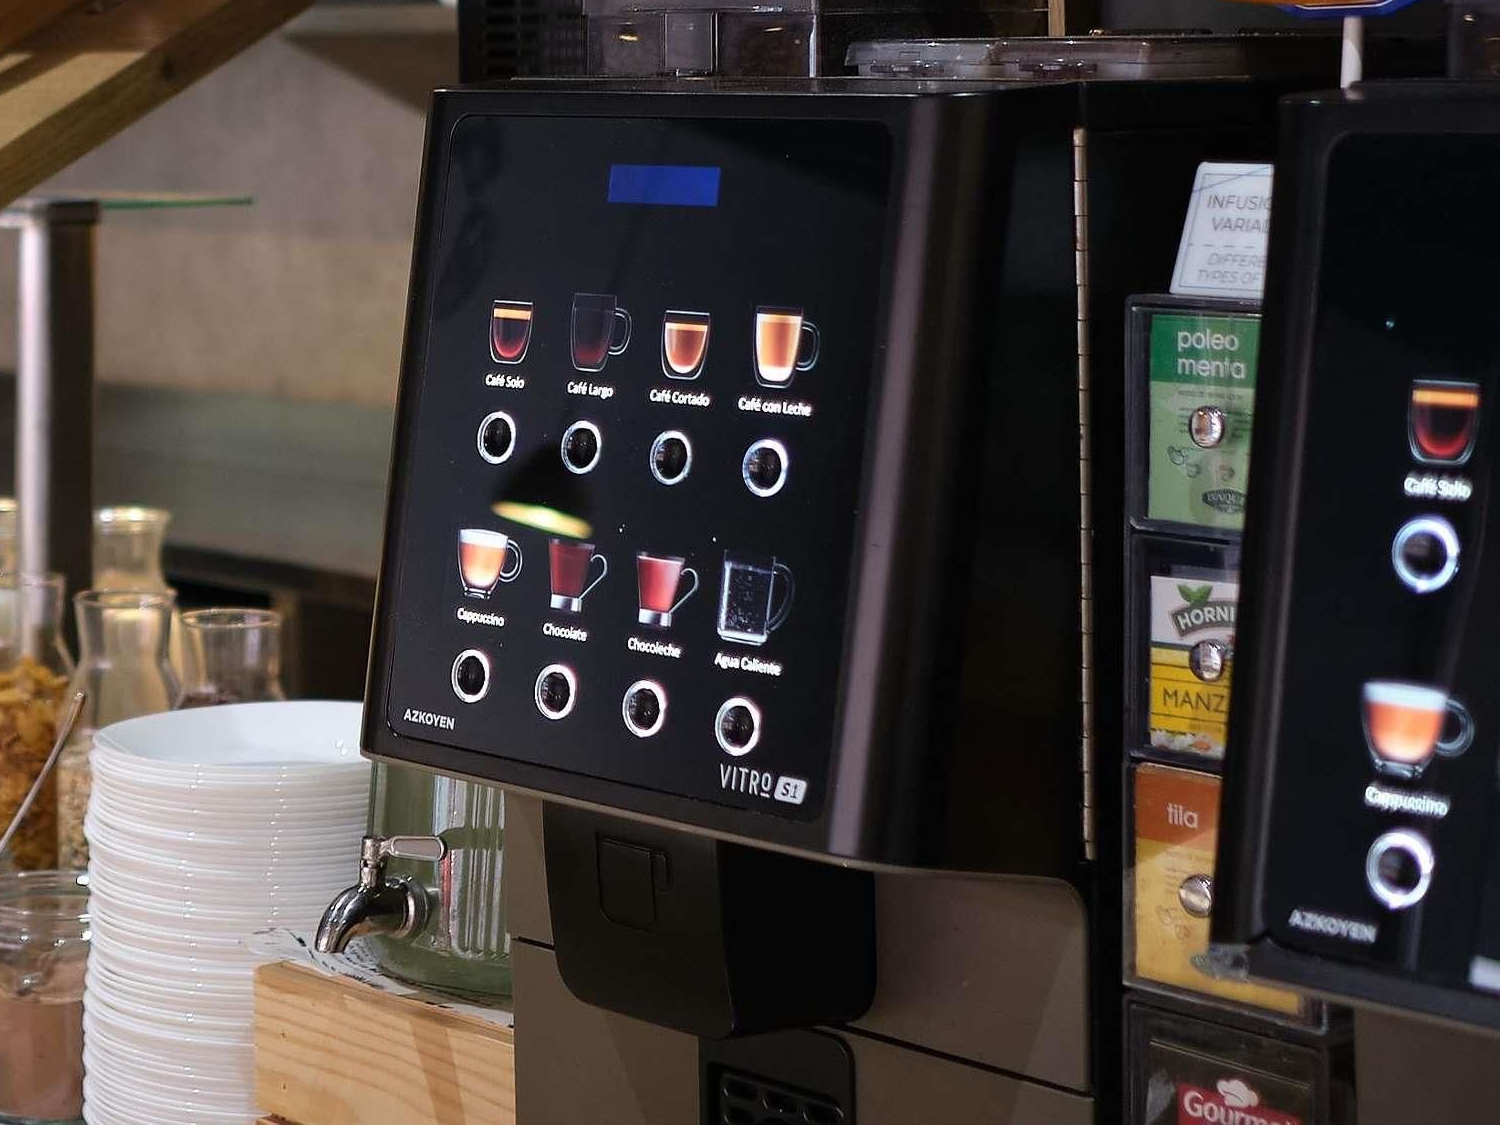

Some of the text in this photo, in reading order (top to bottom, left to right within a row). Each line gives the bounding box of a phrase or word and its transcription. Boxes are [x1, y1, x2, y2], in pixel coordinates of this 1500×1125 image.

[1177, 329, 1239, 352] poleo
[1178, 357, 1246, 379] menta
[485, 374, 525, 389] Café Solo
[567, 381, 613, 399] Café Largo
[650, 389, 710, 406] Café Cortado
[738, 397, 811, 416] Café con Leche
[1404, 475, 1472, 501] Café Solo
[457, 607, 504, 626] Cappuccino
[543, 623, 587, 641] Chocolate
[628, 637, 681, 658] Chocoleche
[714, 652, 781, 676] Agua Caliente
[1163, 688, 1228, 714] MANZ
[403, 708, 455, 730] AZKOYEN
[781, 782, 798, 798] S1
[1167, 803, 1199, 829] tila
[1288, 909, 1377, 943] AZKOYEN
[1183, 1090, 1300, 1125] Gourm
